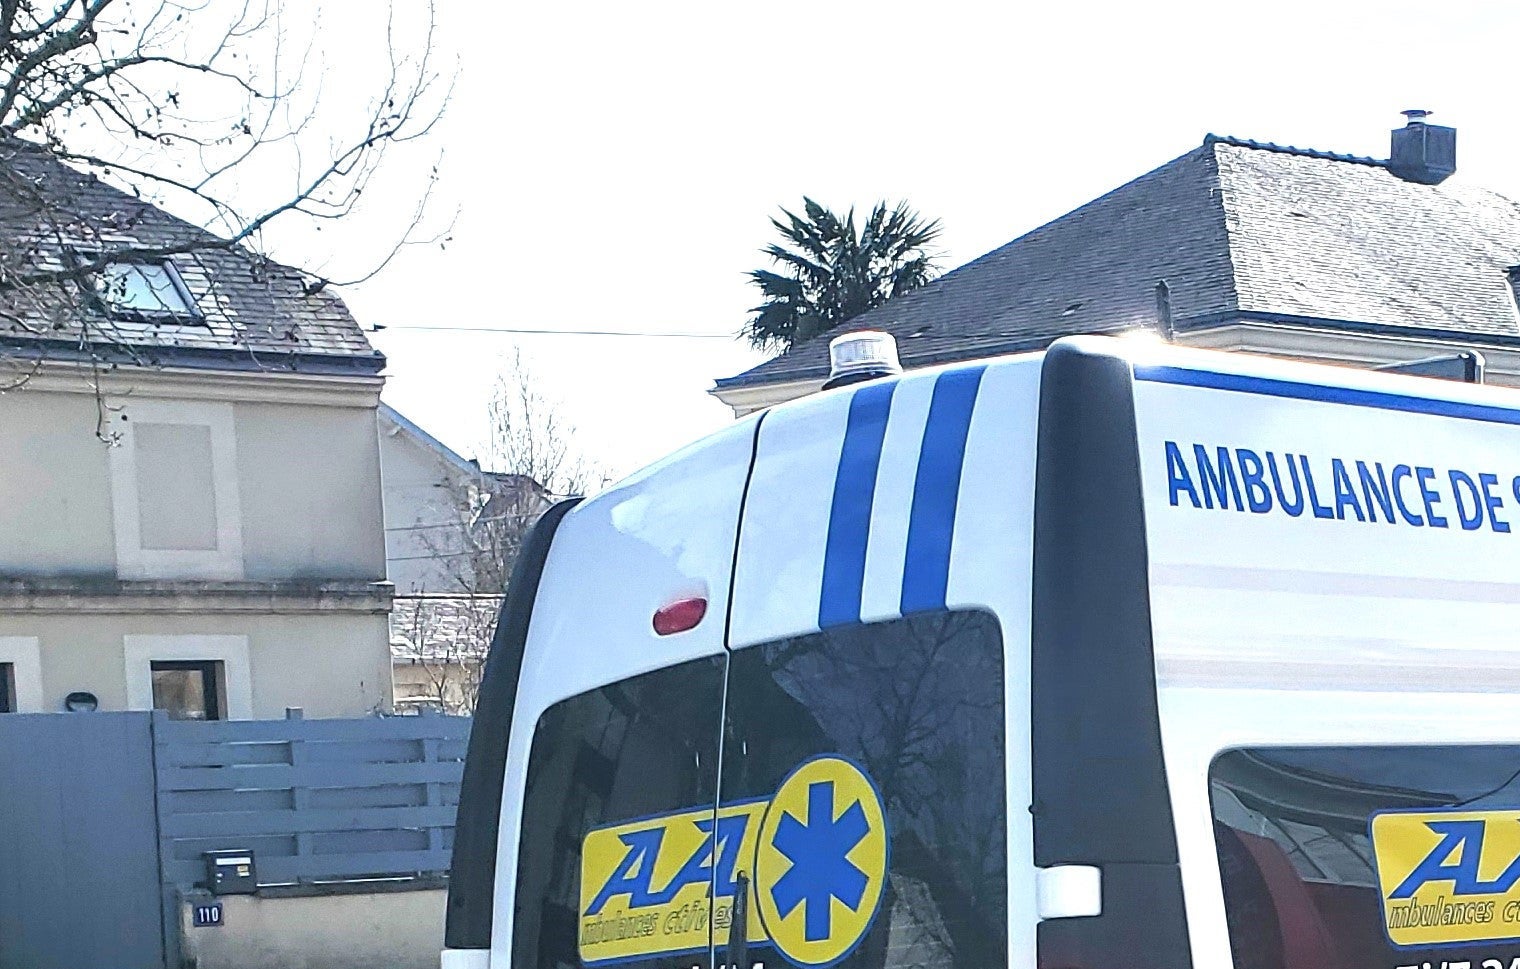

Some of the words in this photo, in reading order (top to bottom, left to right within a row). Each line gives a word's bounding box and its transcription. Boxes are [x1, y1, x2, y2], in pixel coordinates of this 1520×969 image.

[1165, 441, 1449, 528] AMBULANCE
[1449, 469, 1510, 533] DE
[583, 813, 750, 917] AA
[199, 907, 219, 923] 110
